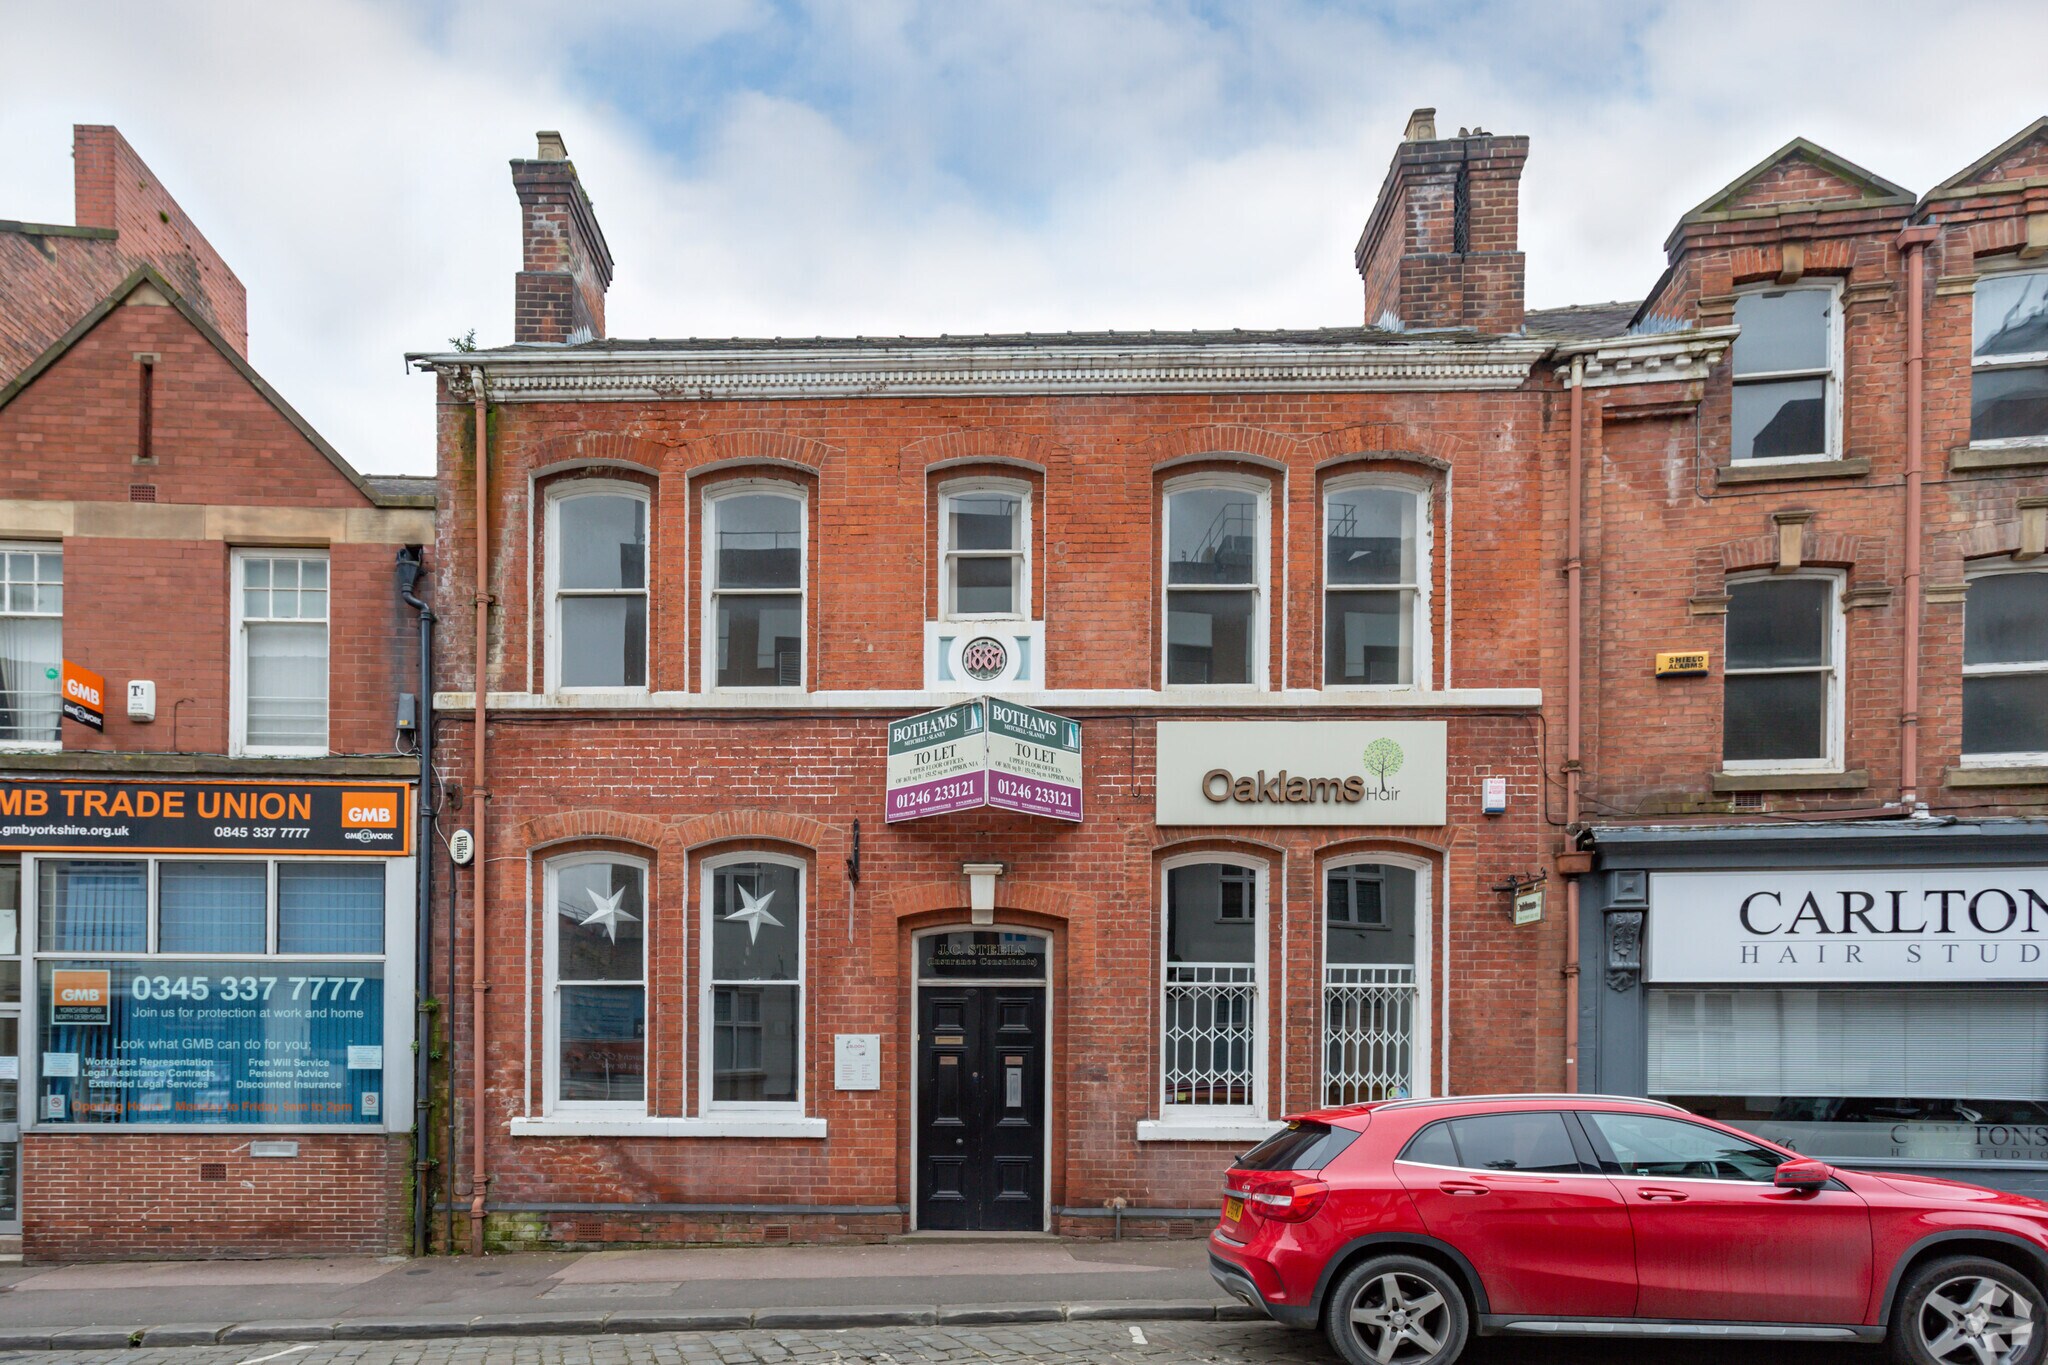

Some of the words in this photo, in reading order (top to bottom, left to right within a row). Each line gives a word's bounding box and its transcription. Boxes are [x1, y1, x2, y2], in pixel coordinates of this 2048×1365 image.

[966, 646, 1002, 670] 1887
[67, 679, 99, 705] GMB
[893, 712, 958, 743] BOTHAMS
[992, 705, 1057, 736] BOTHAMS
[914, 751, 930, 766] TO
[934, 744, 957, 761] LET
[1015, 742, 1031, 758] TO
[1034, 747, 1056, 764] LET
[997, 778, 1031, 800] 01246
[1035, 787, 1072, 807] 233121
[1202, 768, 1366, 803] Oaklams
[1366, 786, 1401, 801] Hair
[896, 789, 930, 809] 01246
[934, 780, 974, 802] 233121
[60, 790, 185, 818] TRADE
[197, 792, 311, 820] UNION
[348, 807, 391, 823] GMB
[214, 826, 248, 838] 0845
[252, 827, 276, 838] 337
[279, 828, 310, 839] 7777
[344, 829, 393, 843] GMB@WORK
[1739, 888, 2048, 936] CARLTON
[967, 944, 1027, 956] STEELS
[1740, 944, 1864, 963] HAIR
[1907, 943, 2041, 963] STUD
[61, 989, 100, 1002] GMB
[132, 976, 210, 1001] 0345
[220, 976, 278, 1001] 337
[288, 977, 365, 1001] 7777
[132, 1008, 158, 1018] Join
[160, 1010, 175, 1018] us
[178, 1007, 194, 1018] for
[197, 1008, 256, 1020] protection
[259, 1009, 271, 1018] at
[274, 1008, 302, 1018] work
[305, 1008, 327, 1018] and
[330, 1008, 364, 1018] home
[113, 1038, 145, 1049] Look
[148, 1038, 178, 1049] what
[182, 1038, 214, 1050] GMB
[217, 1041, 240, 1050] can
[244, 1039, 261, 1050] do
[264, 1039, 281, 1050] for
[85, 1057, 137, 1067] Workplace
[139, 1057, 214, 1067] Representation
[248, 1058, 271, 1067] Free
[273, 1058, 291, 1067] Will
[293, 1058, 330, 1067] Service
[82, 1069, 109, 1078] Legal
[249, 1069, 294, 1078] Pensions
[296, 1069, 329, 1078] Advice
[88, 1079, 135, 1088] Extended
[137, 1079, 165, 1090] Legal
[166, 1079, 209, 1088] Services
[236, 1080, 291, 1089] Discounted
[294, 1080, 342, 1089] Insurance
[71, 1101, 123, 1113] Opening
[227, 1102, 239, 1111] to
[242, 1101, 279, 1113] Friday
[311, 1102, 324, 1111] to
